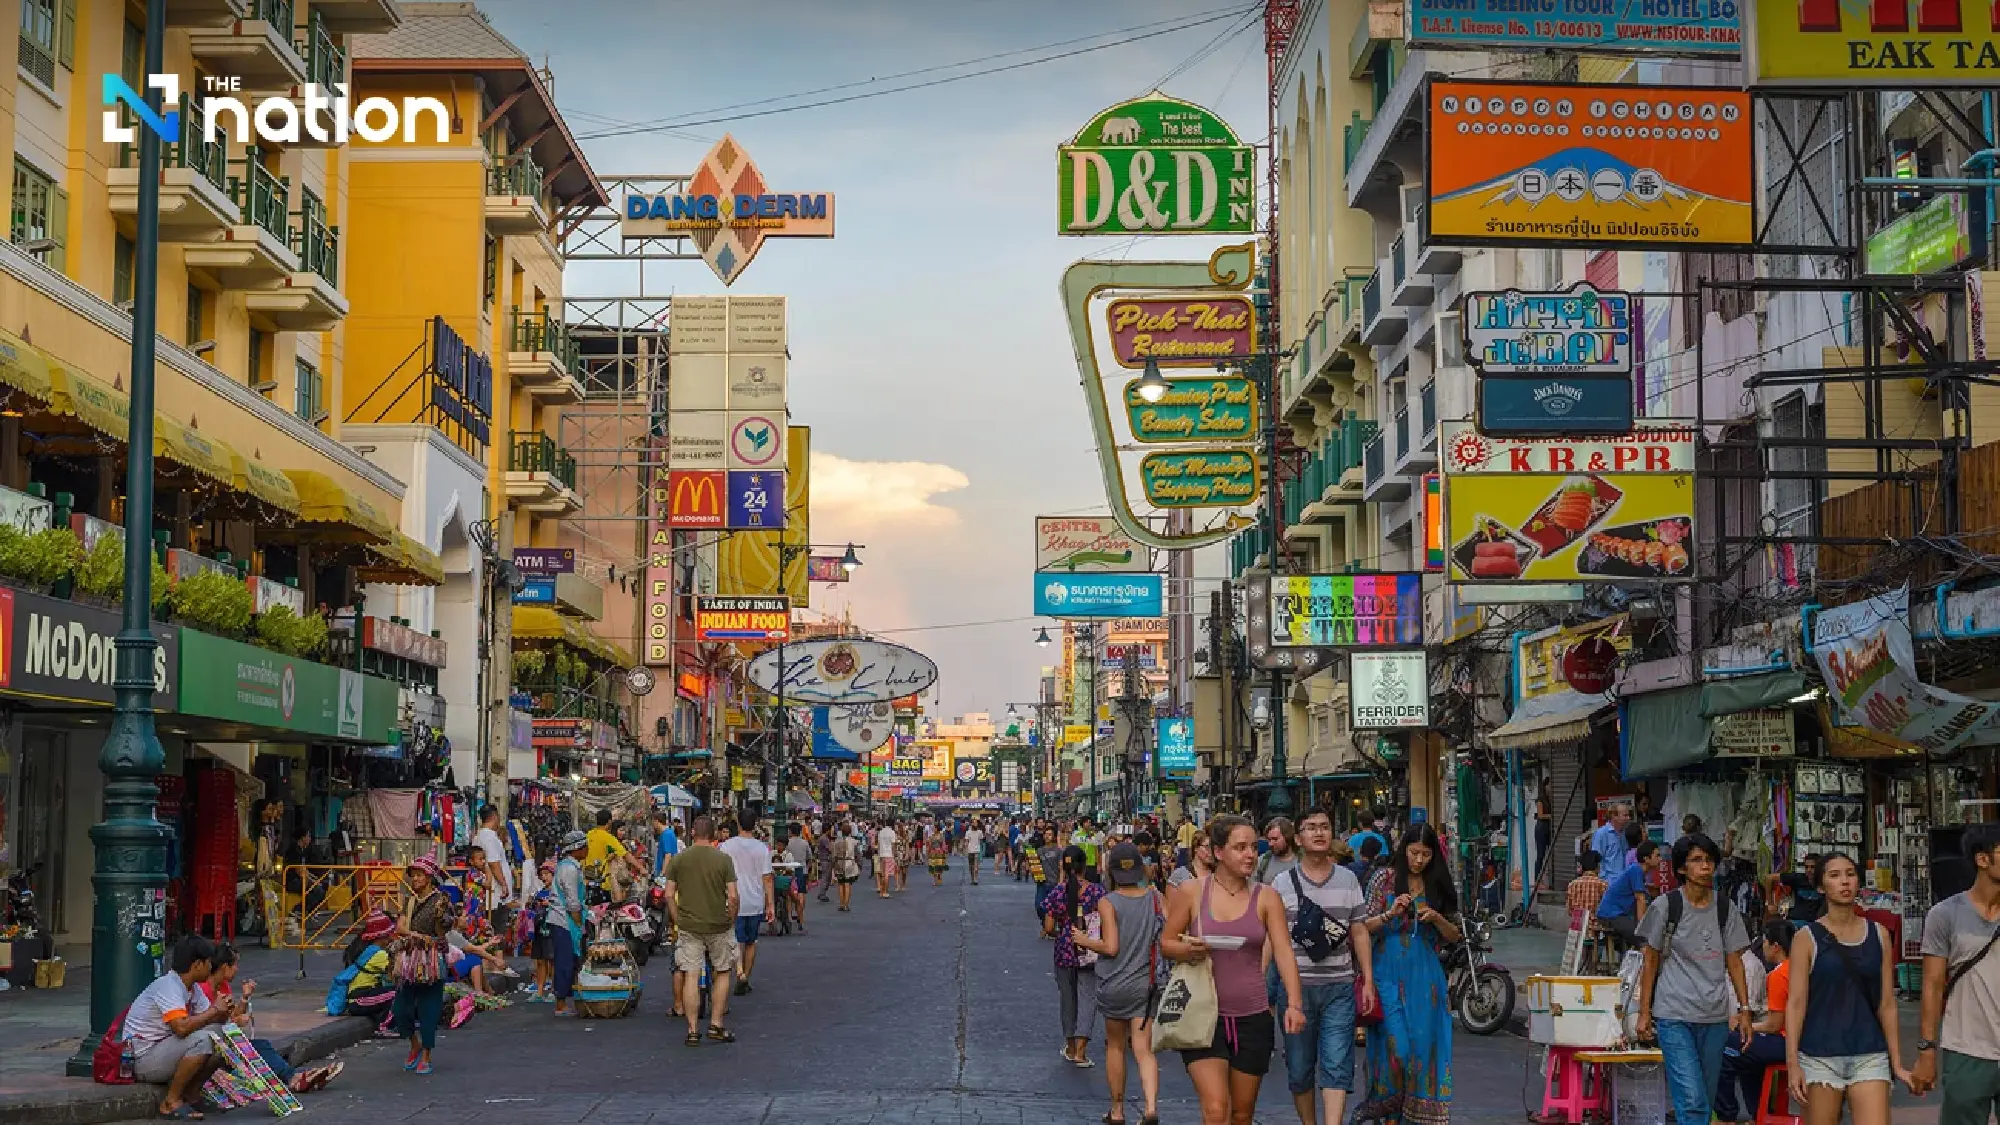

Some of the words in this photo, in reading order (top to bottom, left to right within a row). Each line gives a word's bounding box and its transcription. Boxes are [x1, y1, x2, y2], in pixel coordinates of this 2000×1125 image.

[1563, 0, 1614, 15] TOUR
[1642, 0, 1700, 17] HOTEL
[1708, 1, 1740, 18] BO
[1421, 18, 1456, 32] T.A.T.
[1508, 21, 1530, 35] No.
[1536, 21, 1602, 38] 13/00613
[1848, 41, 1935, 68] EAK
[1946, 41, 2000, 68] TA
[1443, 96, 1571, 117] NIPPON
[1591, 98, 1738, 120] ICHIBAN
[1162, 122, 1178, 135] The
[1182, 122, 1203, 135] best
[1204, 136, 1227, 144] Road
[1067, 151, 1218, 230] D&D
[1228, 151, 1250, 225] INN
[1520, 172, 1662, 199] 日本一番
[627, 194, 719, 220] DANG
[735, 194, 827, 220] DERM
[1486, 216, 1600, 239] ร้านอาหารญี่ปุ่น
[1131, 334, 1235, 357] Restaurant
[1130, 388, 1210, 409] Smming
[1140, 410, 1194, 436] Beauty
[1197, 409, 1246, 430] Salon
[1146, 460, 1184, 477] Thai
[743, 491, 768, 509] 24
[1153, 481, 1210, 501] Shopping
[1040, 521, 1103, 535] CENTER
[514, 556, 544, 568] ATM
[703, 600, 737, 610] TASTE
[738, 600, 752, 610] OF
[753, 600, 784, 610] INDIA
[650, 580, 668, 660] FOOD
[700, 613, 749, 629] INDIAN
[751, 613, 787, 629] FOOD
[1114, 620, 1142, 631] SIAM
[850, 662, 926, 689] Club
[1357, 705, 1426, 717] FERRIDER
[891, 759, 921, 769] BAG
